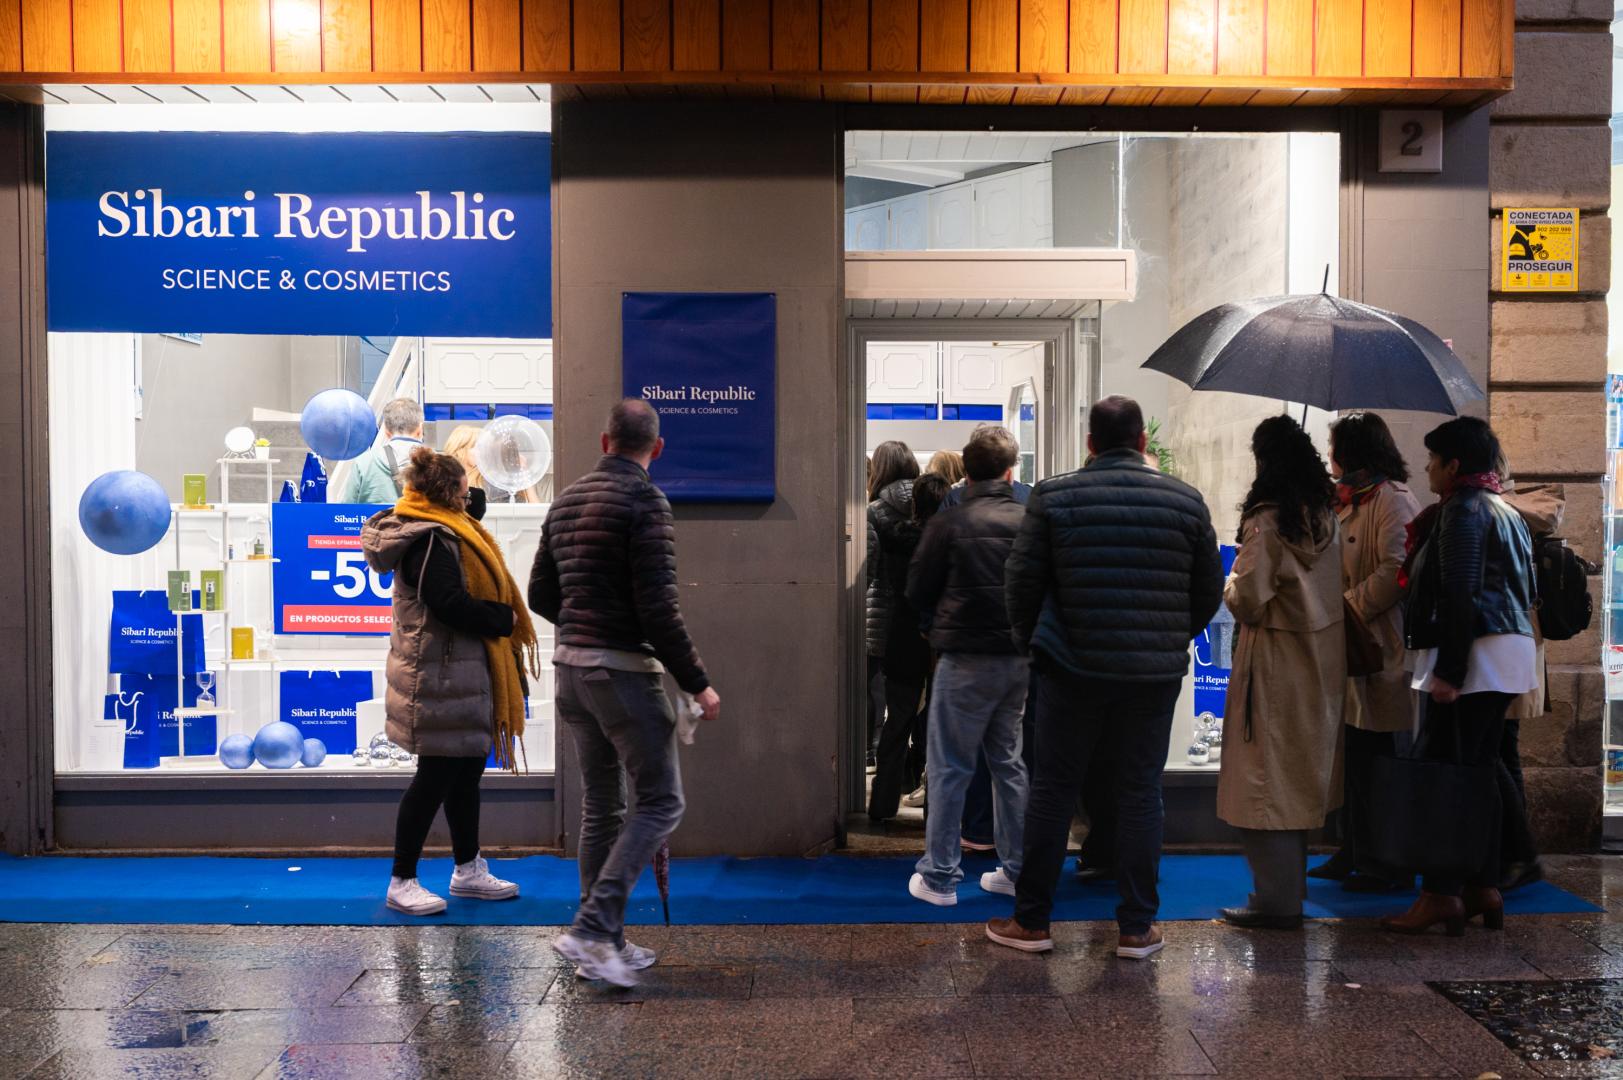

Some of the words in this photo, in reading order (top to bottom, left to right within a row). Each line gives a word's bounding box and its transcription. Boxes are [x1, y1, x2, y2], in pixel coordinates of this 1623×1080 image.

[1401, 120, 1423, 156] 2
[98, 188, 260, 238] Sibari
[274, 190, 516, 252] Republic
[1510, 212, 1573, 220] CONECTADA
[1508, 262, 1572, 271] PROSEGUR
[162, 268, 271, 290] SCIENCE
[279, 269, 296, 290] &
[304, 269, 450, 291] COSMETICS
[641, 385, 686, 400] Sibari
[690, 386, 756, 403] Republic
[698, 407, 738, 415] COSMETICS
[334, 515, 359, 523] Sibari
[290, 615, 303, 623] EN
[306, 615, 361, 624] PRODUCTOS
[121, 627, 146, 636] Sibari
[148, 628, 183, 638] Republ
[291, 708, 317, 717] Sibari
[319, 708, 357, 718] Republic
